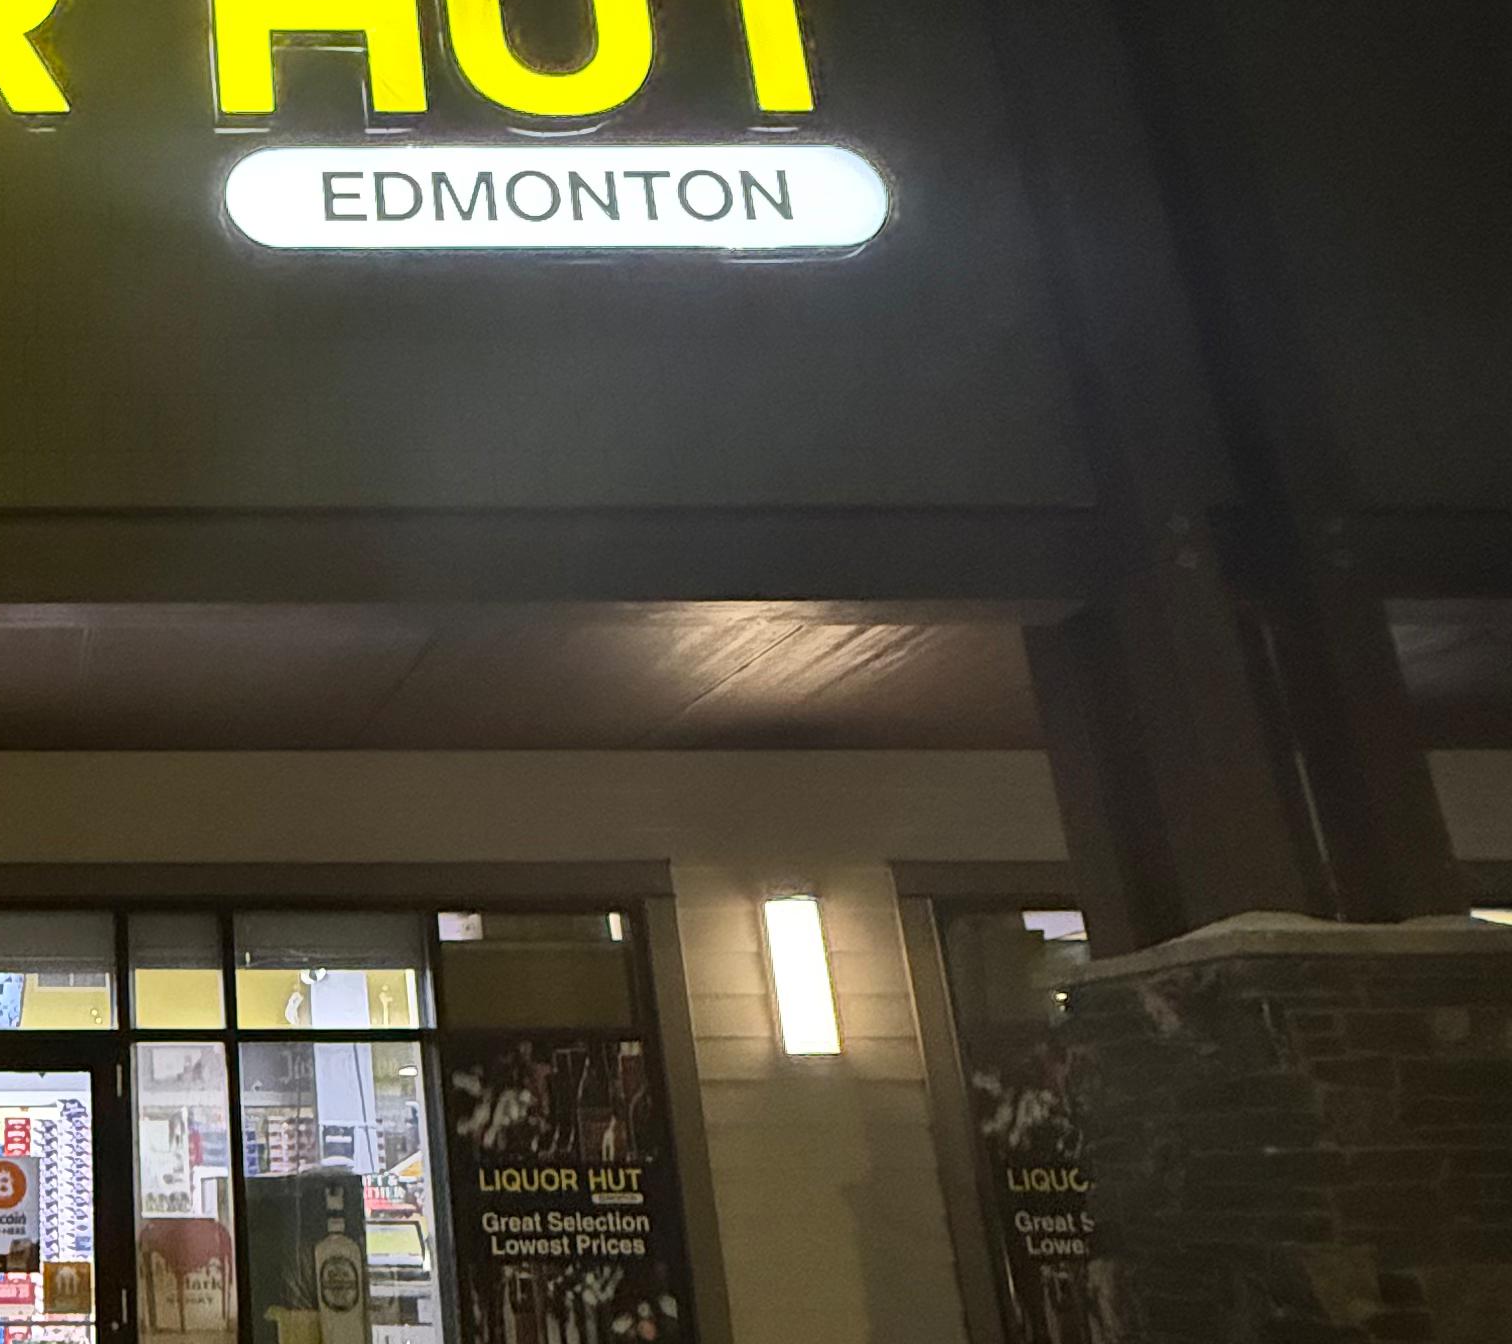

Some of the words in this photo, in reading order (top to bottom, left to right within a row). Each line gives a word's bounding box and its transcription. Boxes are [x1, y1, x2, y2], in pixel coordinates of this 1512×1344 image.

[321, 169, 795, 222] EDMONTON
[478, 1167, 579, 1193] LIQUOR
[588, 1168, 643, 1192] HUT
[1006, 1167, 1097, 1193] LIQUO
[481, 1211, 543, 1233] Great
[547, 1210, 650, 1233] Selection
[1014, 1210, 1077, 1234] Great
[491, 1234, 570, 1256] Lowest
[576, 1234, 646, 1256] Prices
